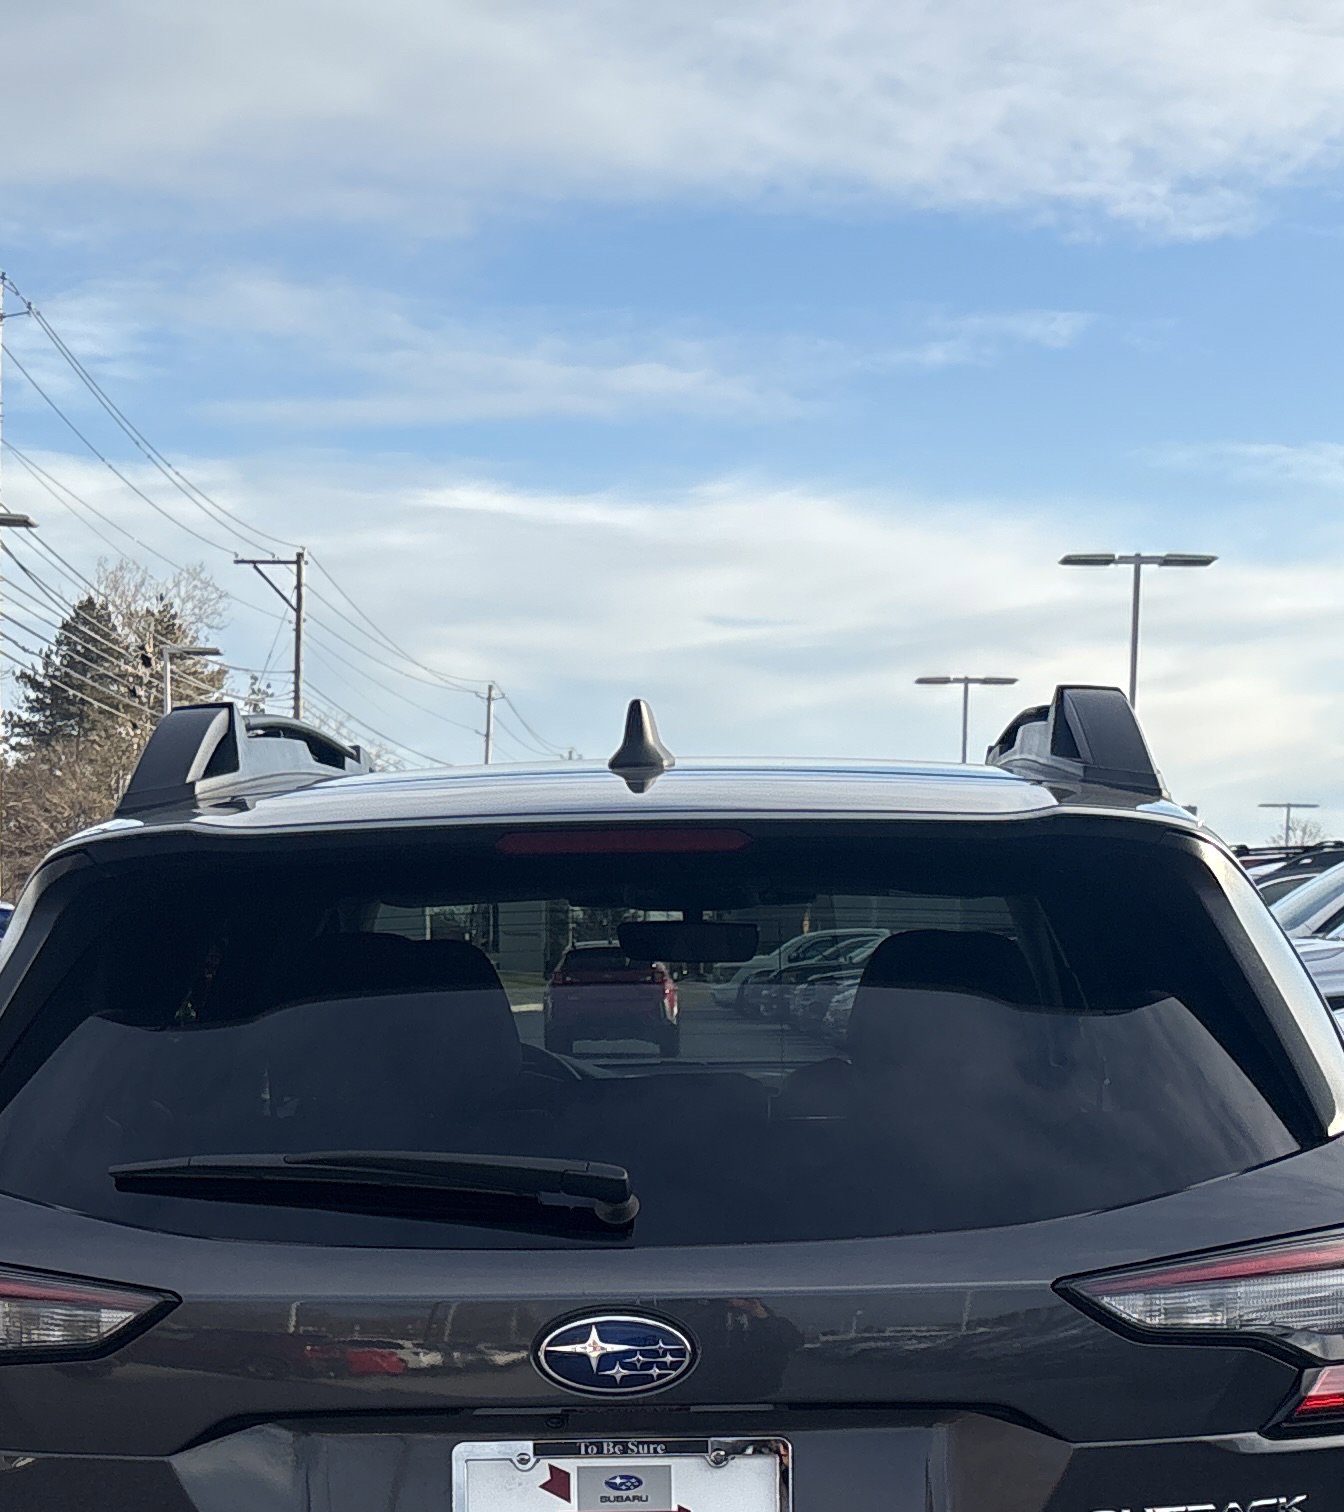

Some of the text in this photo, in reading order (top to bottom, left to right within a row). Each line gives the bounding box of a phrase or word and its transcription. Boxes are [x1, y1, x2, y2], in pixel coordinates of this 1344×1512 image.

[577, 1441, 666, 1455] To Be Sure
[600, 1495, 648, 1503] SUBARU
